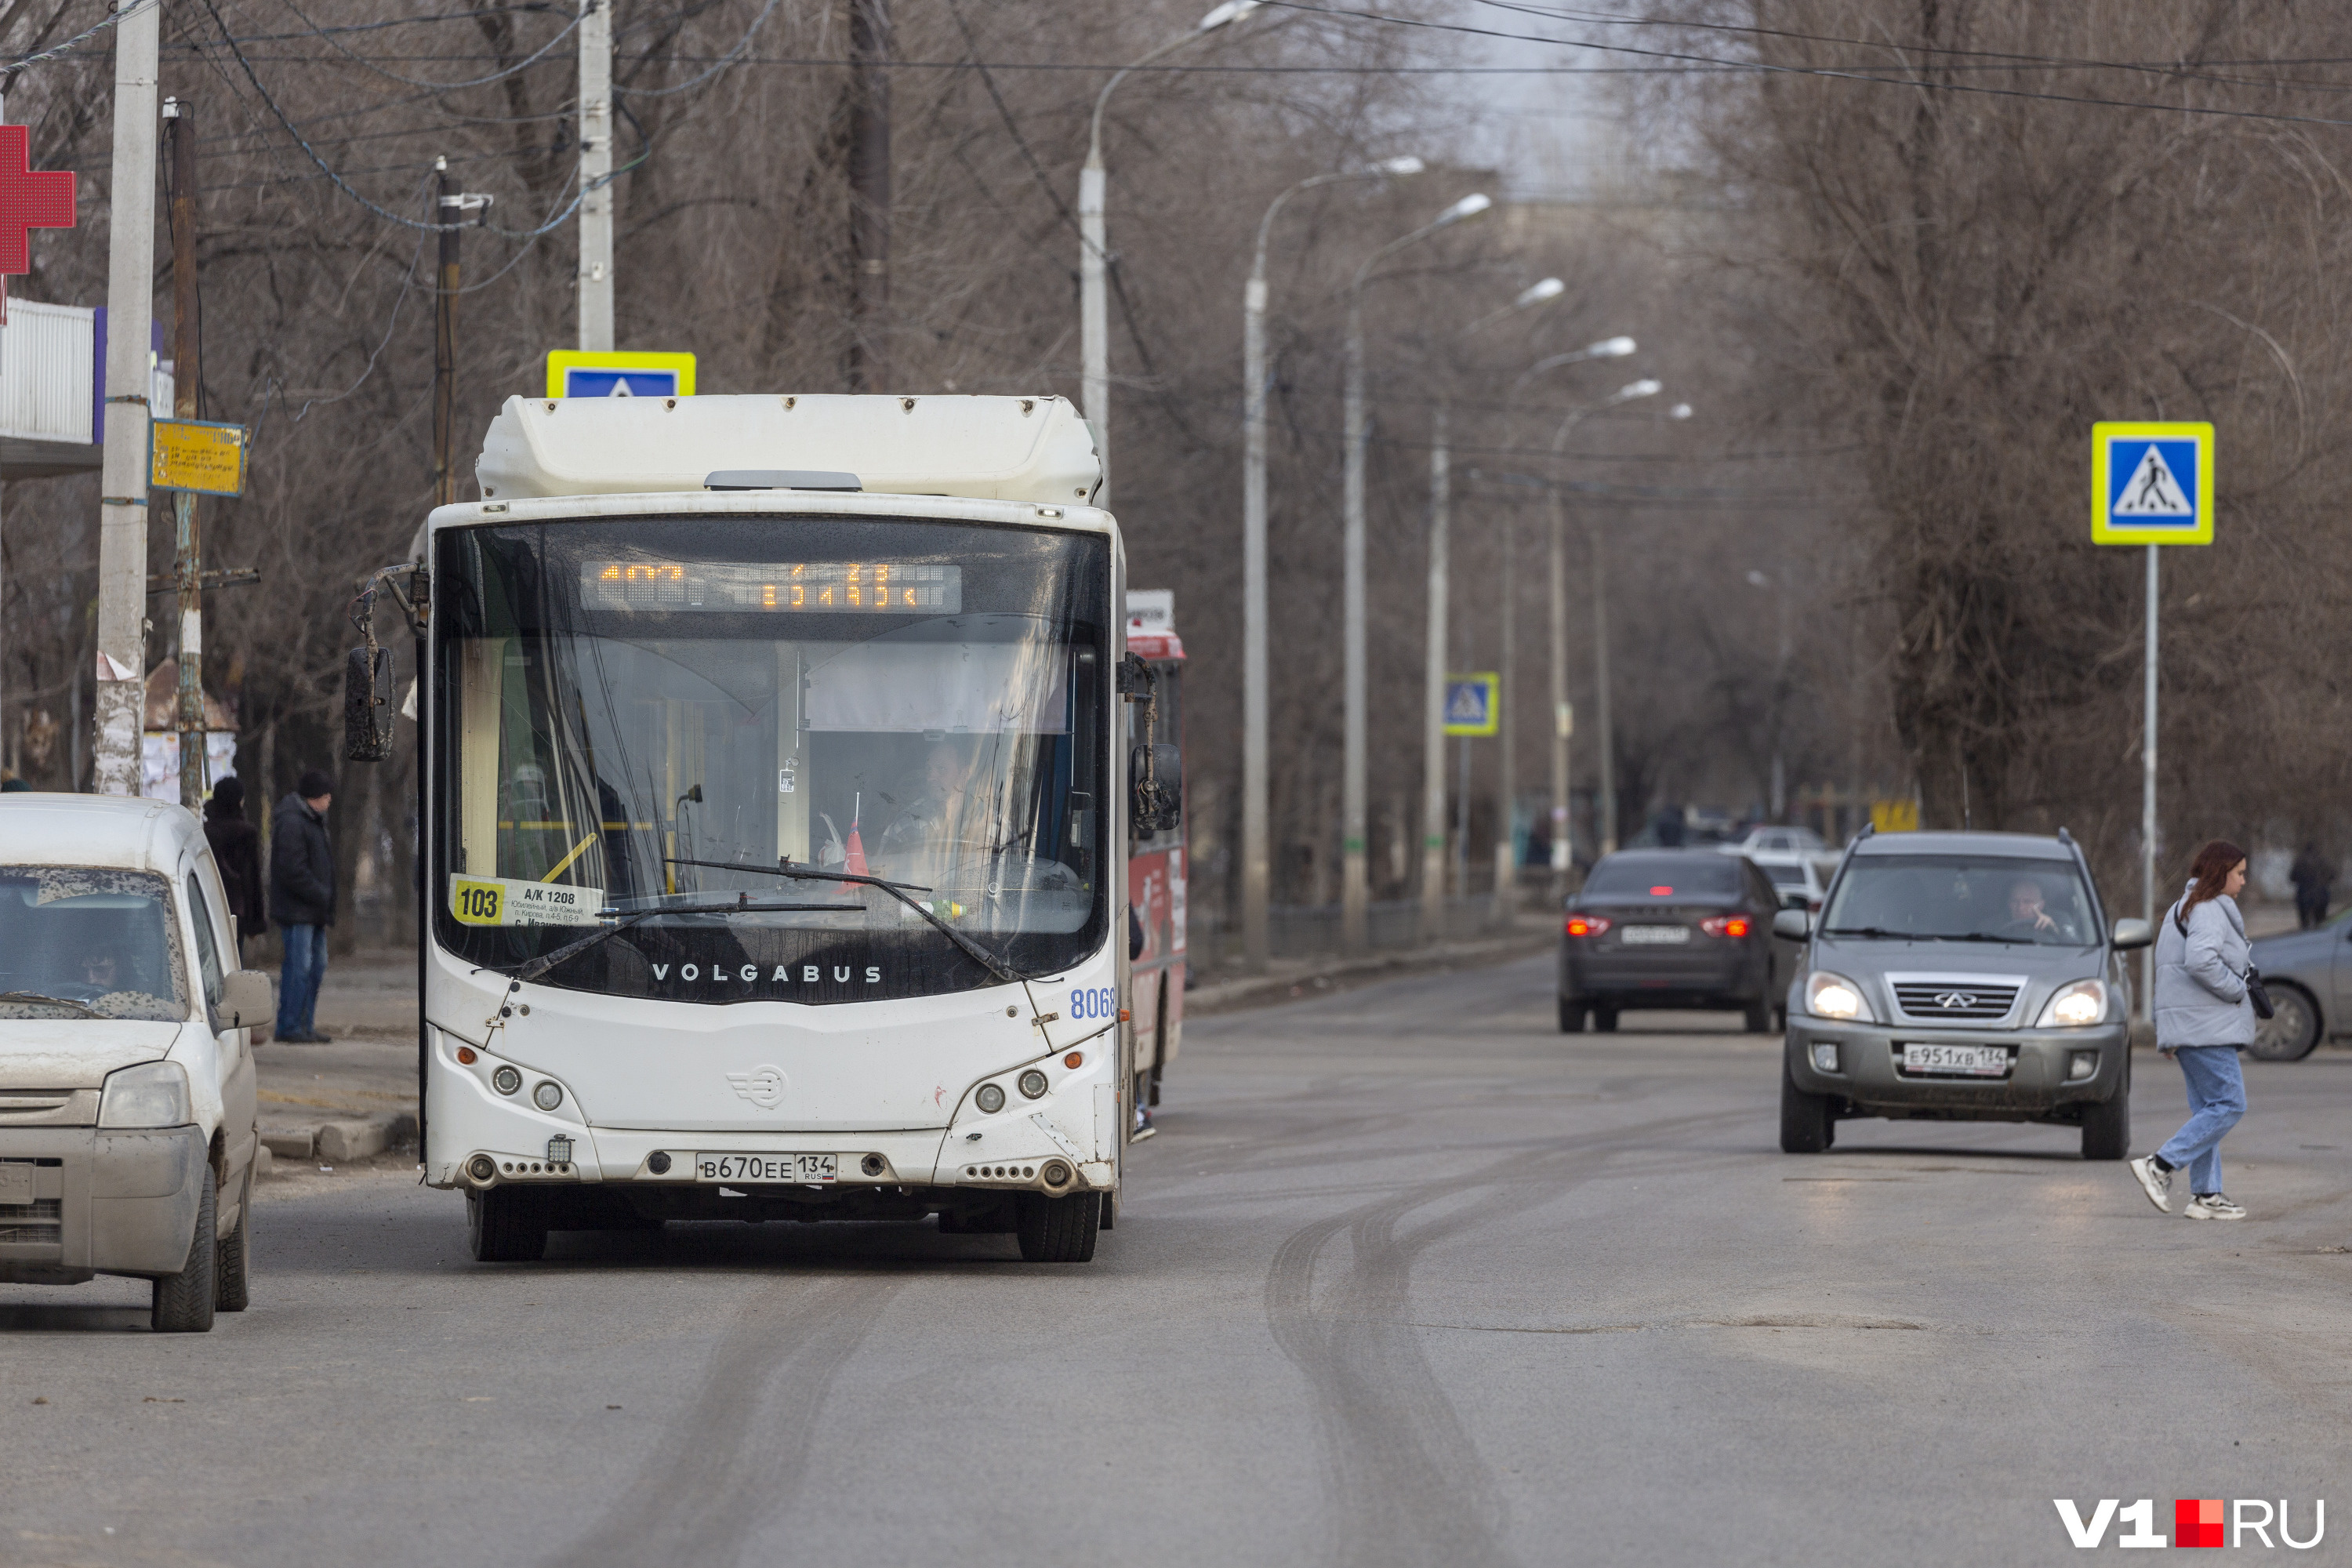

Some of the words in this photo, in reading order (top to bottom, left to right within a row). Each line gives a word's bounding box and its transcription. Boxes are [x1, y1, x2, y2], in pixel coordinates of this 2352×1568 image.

[461, 888, 498, 918] 103
[524, 888, 543, 901] А/К
[547, 891, 575, 904] 1208
[511, 900, 547, 911] Юбилейный,
[559, 906, 584, 916] Южный,
[521, 910, 544, 919] Кирова,
[652, 964, 880, 982] VOLGABUS
[1071, 987, 1114, 1019] 8068
[704, 1157, 792, 1178] В670ЕЕ
[797, 1156, 830, 1173] 134
